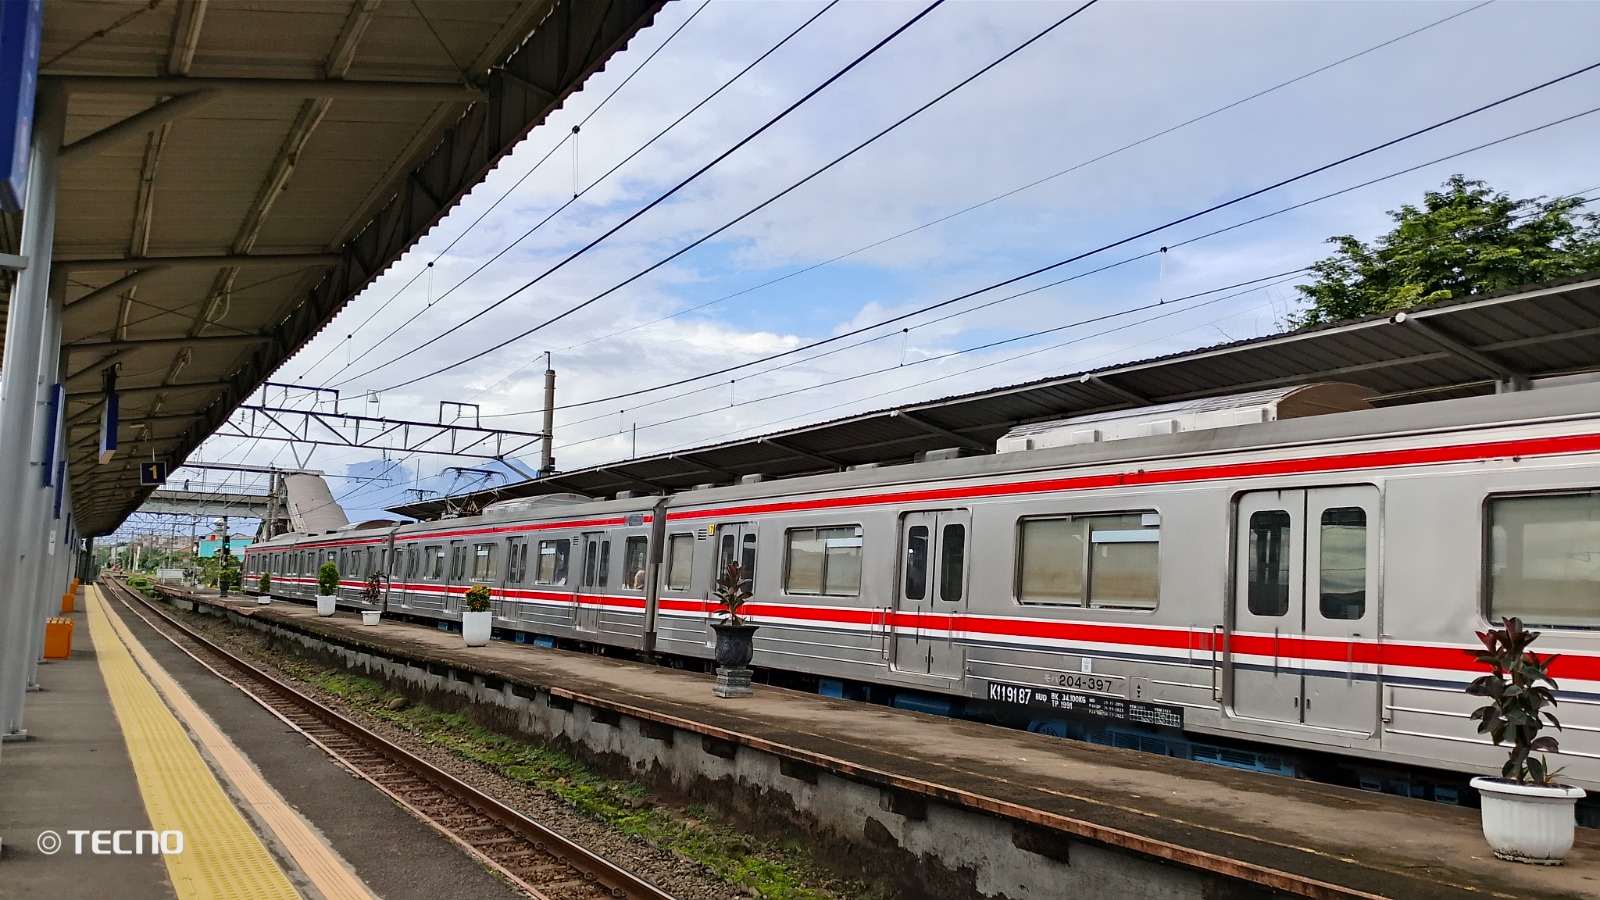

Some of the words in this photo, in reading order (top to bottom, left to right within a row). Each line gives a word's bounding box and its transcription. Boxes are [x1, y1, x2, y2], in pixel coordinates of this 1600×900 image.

[149, 465, 157, 479] 1
[1058, 674, 1112, 692] 204-397
[990, 683, 1032, 705] K119187
